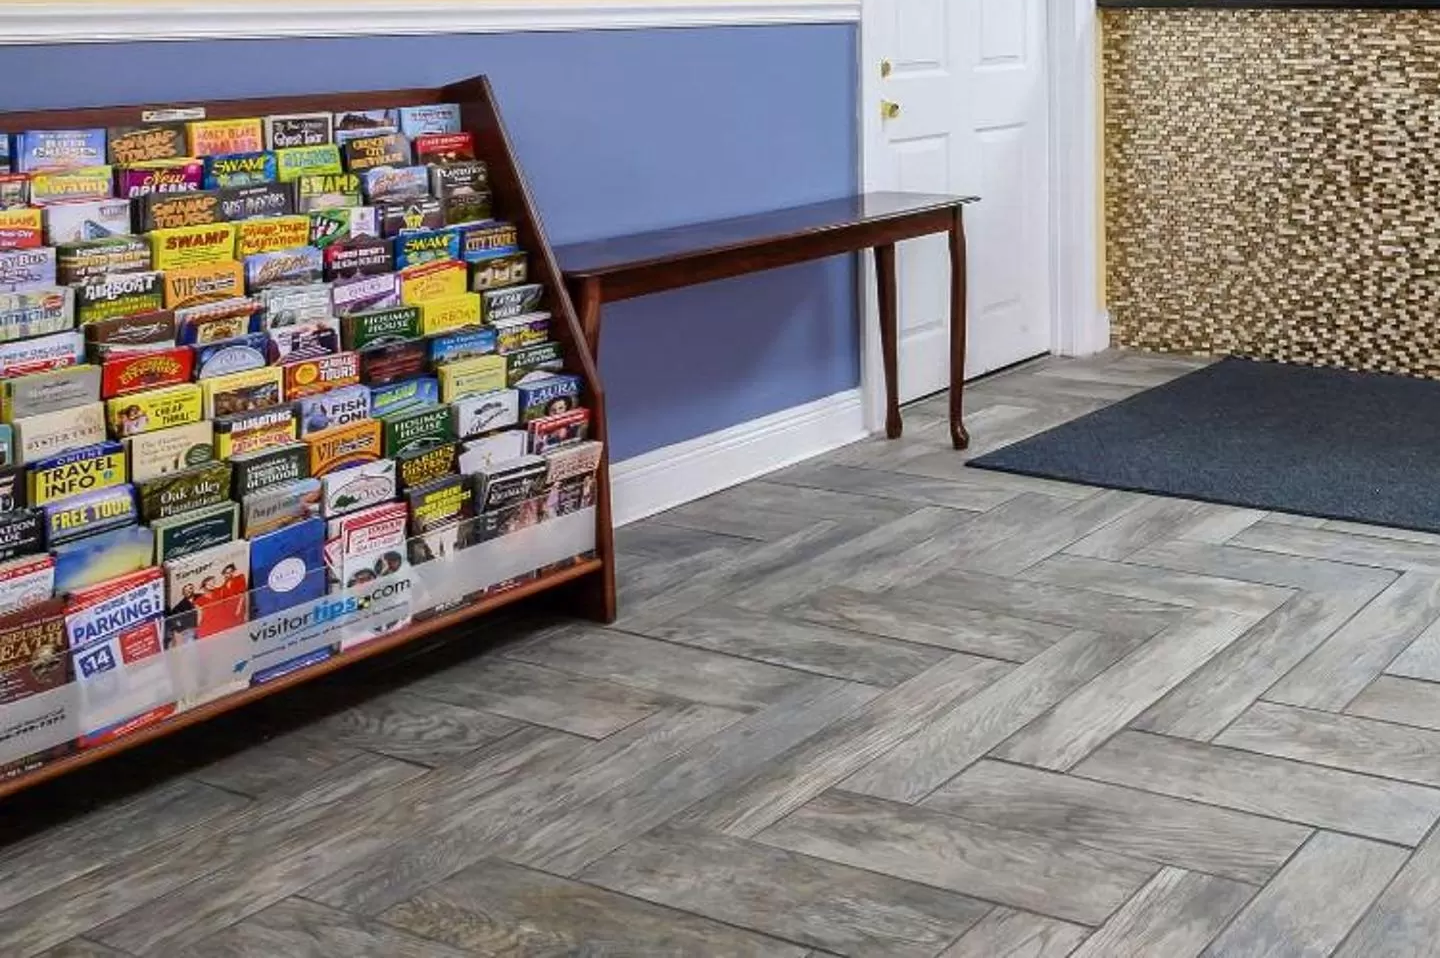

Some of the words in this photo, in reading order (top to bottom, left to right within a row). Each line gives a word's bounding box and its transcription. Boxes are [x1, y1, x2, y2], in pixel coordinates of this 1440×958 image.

[302, 173, 359, 192] SWAMP
[166, 230, 230, 251] SWAMP
[466, 236, 487, 251] CITY
[85, 274, 157, 301] AIRBOAT
[172, 276, 197, 299] VIP
[364, 310, 416, 326] HOUMAS
[367, 320, 409, 334] HOUSE
[527, 380, 578, 407] LAURA
[331, 398, 367, 416] FISH
[395, 409, 449, 433] HOUMAS
[400, 421, 442, 439] HOUSE
[57, 449, 105, 465] ONLINE
[317, 440, 337, 461] VIP
[44, 456, 117, 484] TRAVEL
[45, 475, 96, 499] INFO
[160, 487, 187, 504] Oak
[191, 482, 221, 498] Alley
[51, 507, 88, 531] FREE
[73, 599, 151, 645] PARKING
